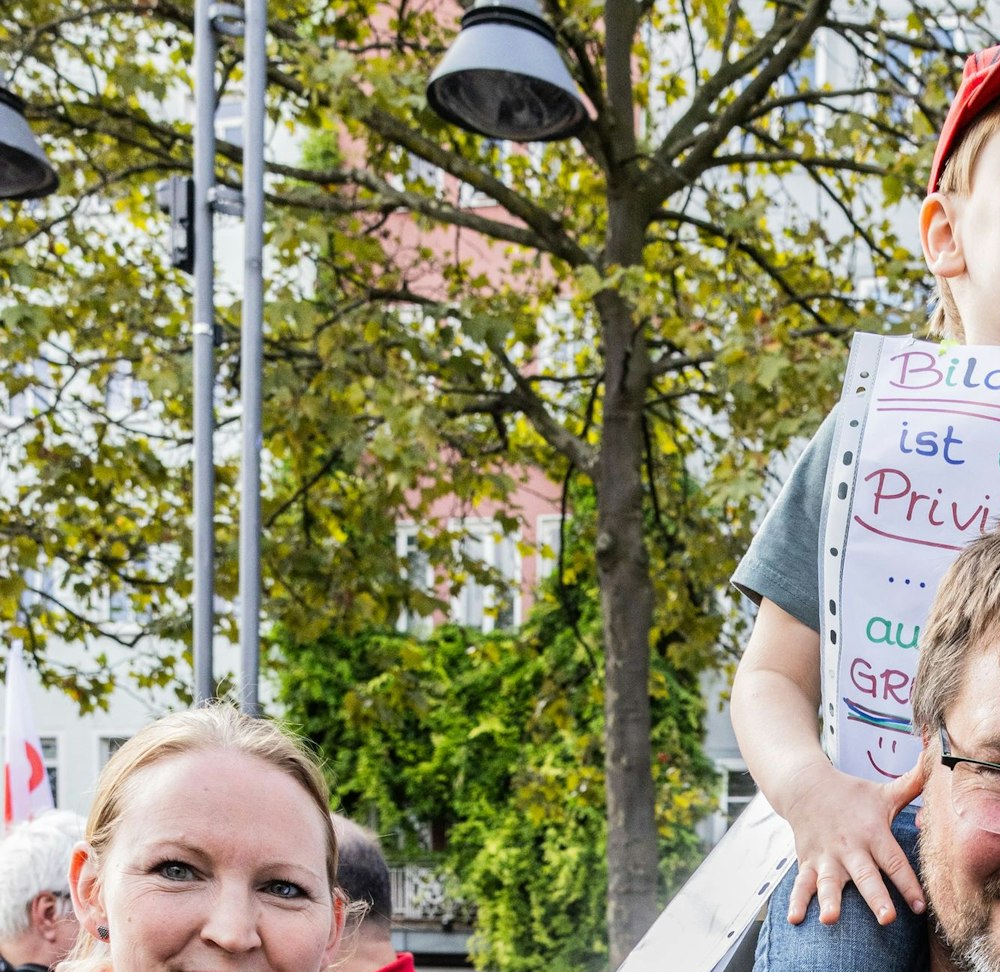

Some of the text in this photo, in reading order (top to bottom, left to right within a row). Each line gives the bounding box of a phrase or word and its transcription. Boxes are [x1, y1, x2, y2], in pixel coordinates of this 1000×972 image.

[900, 420, 965, 466] ist
[865, 616, 921, 649] au
[850, 657, 916, 705] GR
